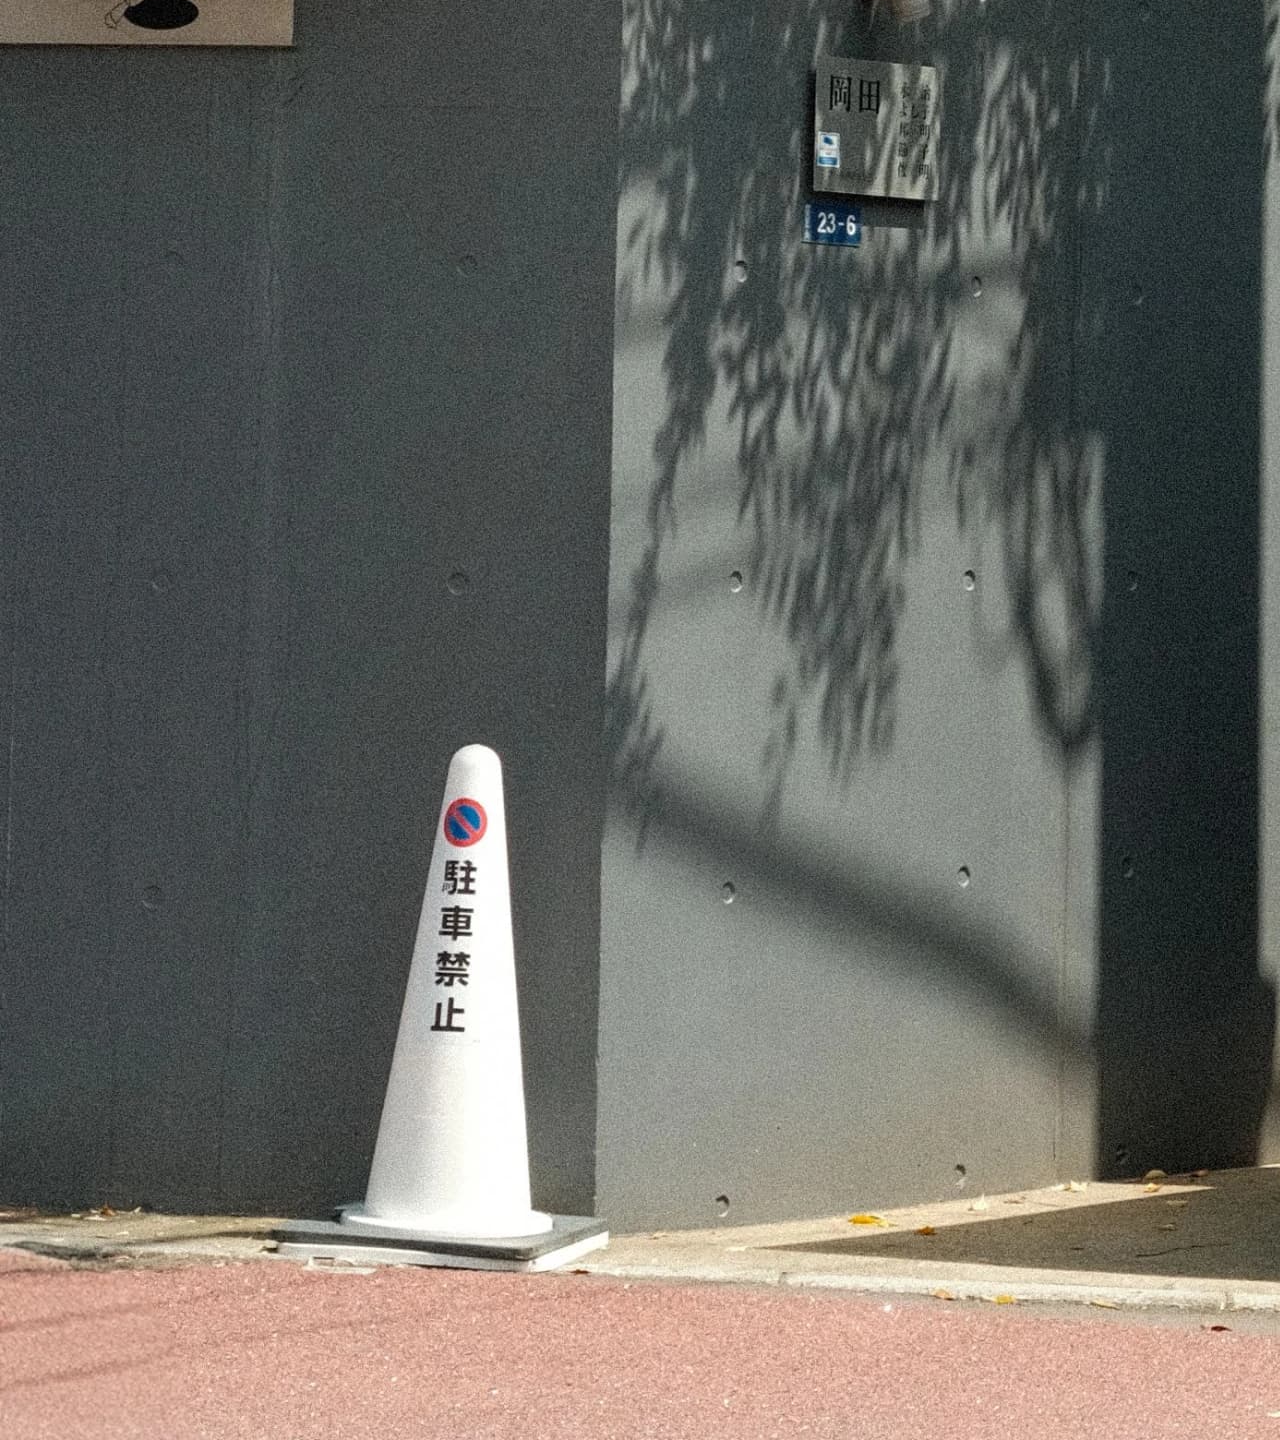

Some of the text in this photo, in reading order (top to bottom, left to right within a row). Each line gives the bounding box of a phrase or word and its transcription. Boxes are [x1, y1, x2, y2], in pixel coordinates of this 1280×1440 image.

[830, 74, 880, 114] 岡田
[817, 212, 857, 237] 23-6
[430, 859, 478, 1033] 駐車禁止
